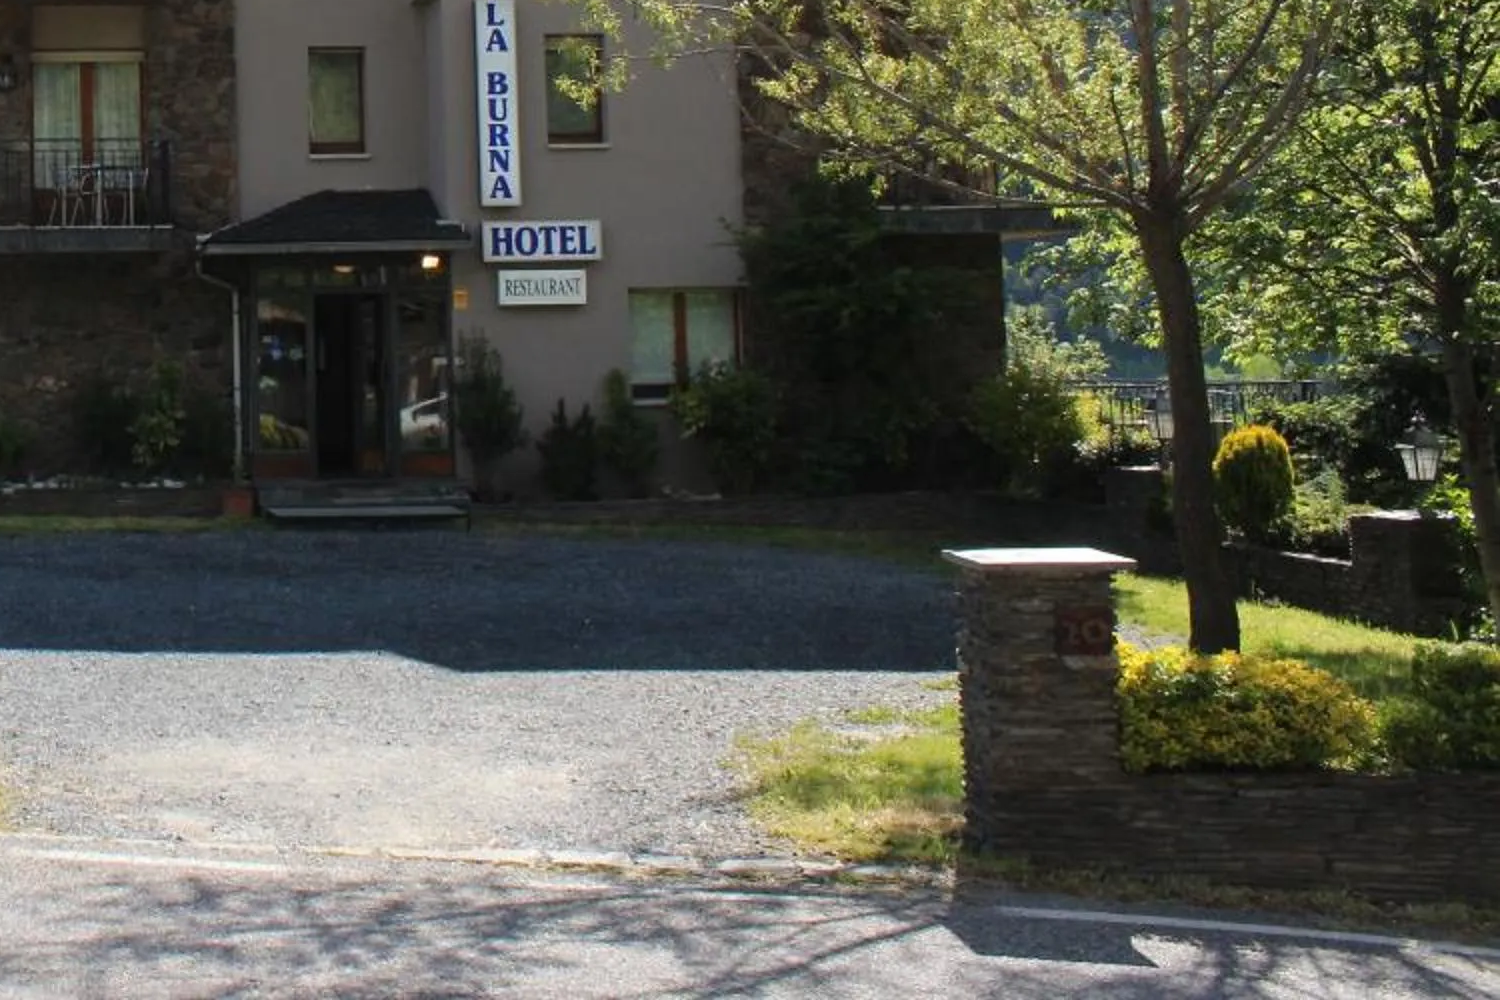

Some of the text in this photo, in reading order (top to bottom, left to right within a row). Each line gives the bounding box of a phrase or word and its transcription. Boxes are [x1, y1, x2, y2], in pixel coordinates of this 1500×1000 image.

[486, 3, 513, 199] LA BURNA
[491, 226, 597, 257] HOTEL
[505, 277, 581, 297] RESTAURANT
